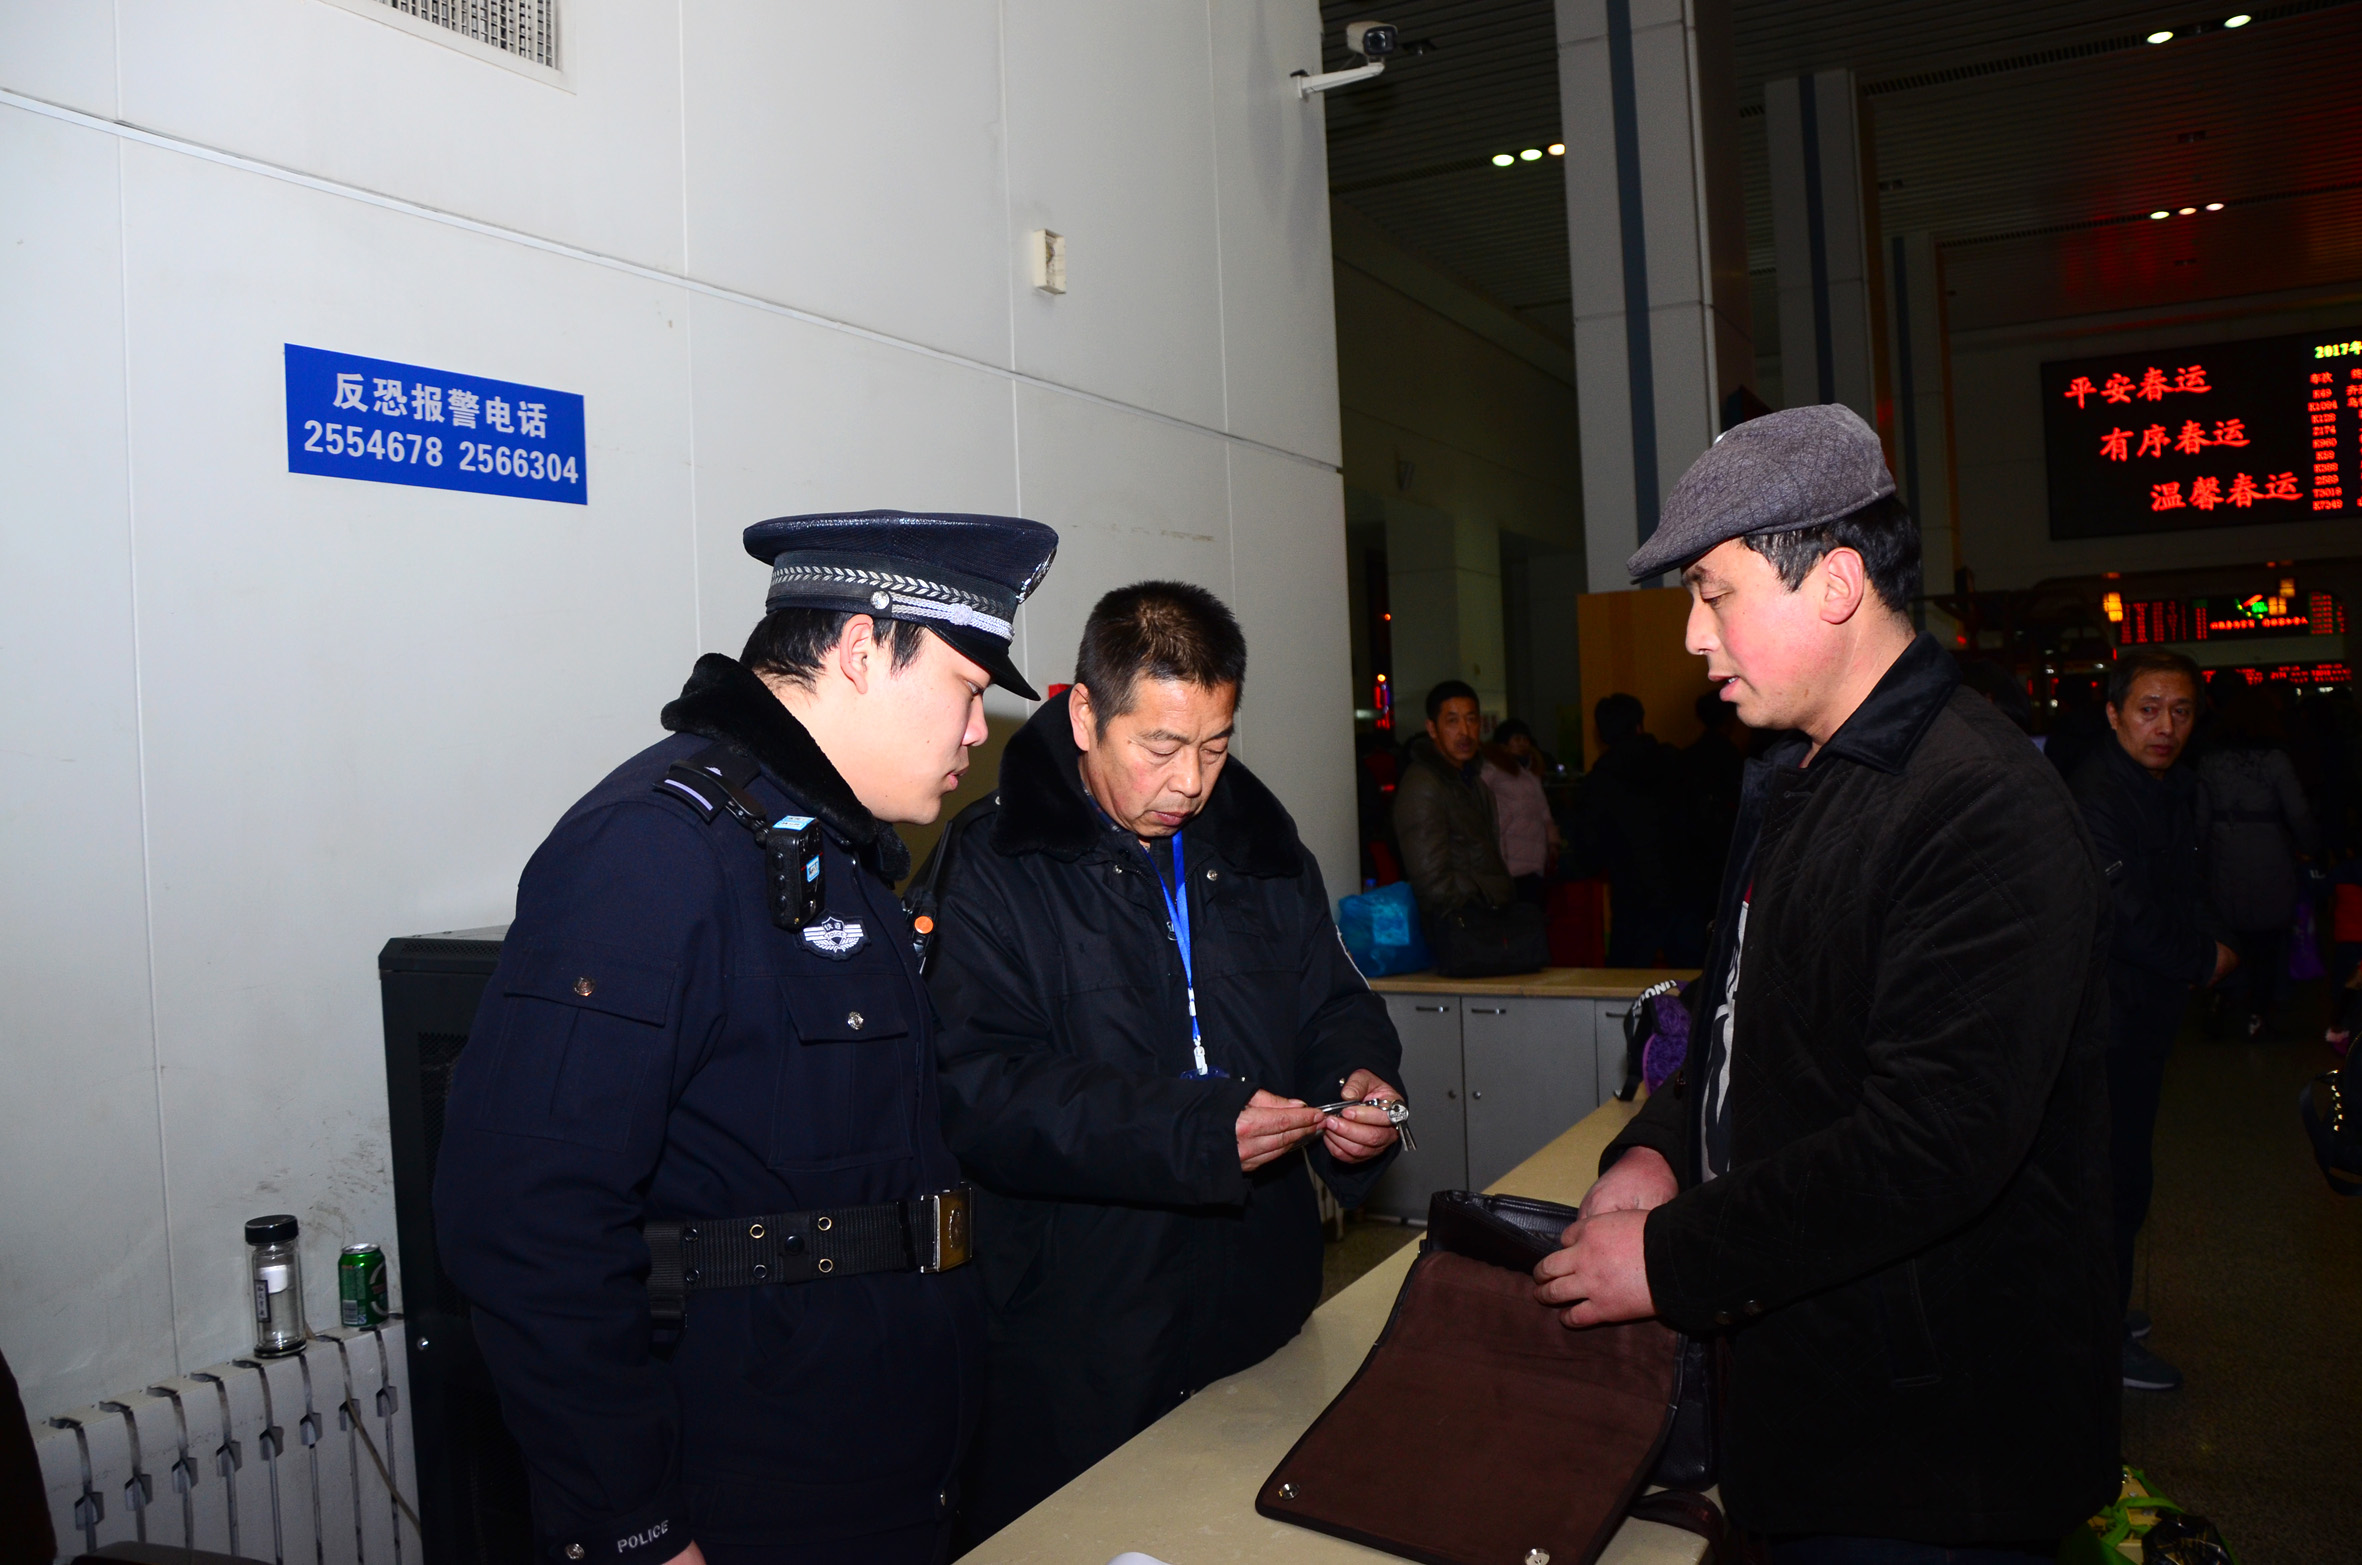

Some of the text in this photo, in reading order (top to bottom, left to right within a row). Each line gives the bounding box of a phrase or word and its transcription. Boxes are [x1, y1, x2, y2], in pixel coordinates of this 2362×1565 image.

[333, 372, 548, 439] 反恐报警电话
[2064, 364, 2212, 410] 平安春运
[304, 420, 579, 484] 2554678 2566304
[2100, 418, 2251, 462] 有序春运
[2150, 471, 2304, 512] 温馨春运
[617, 1519, 669, 1553] POLICE
